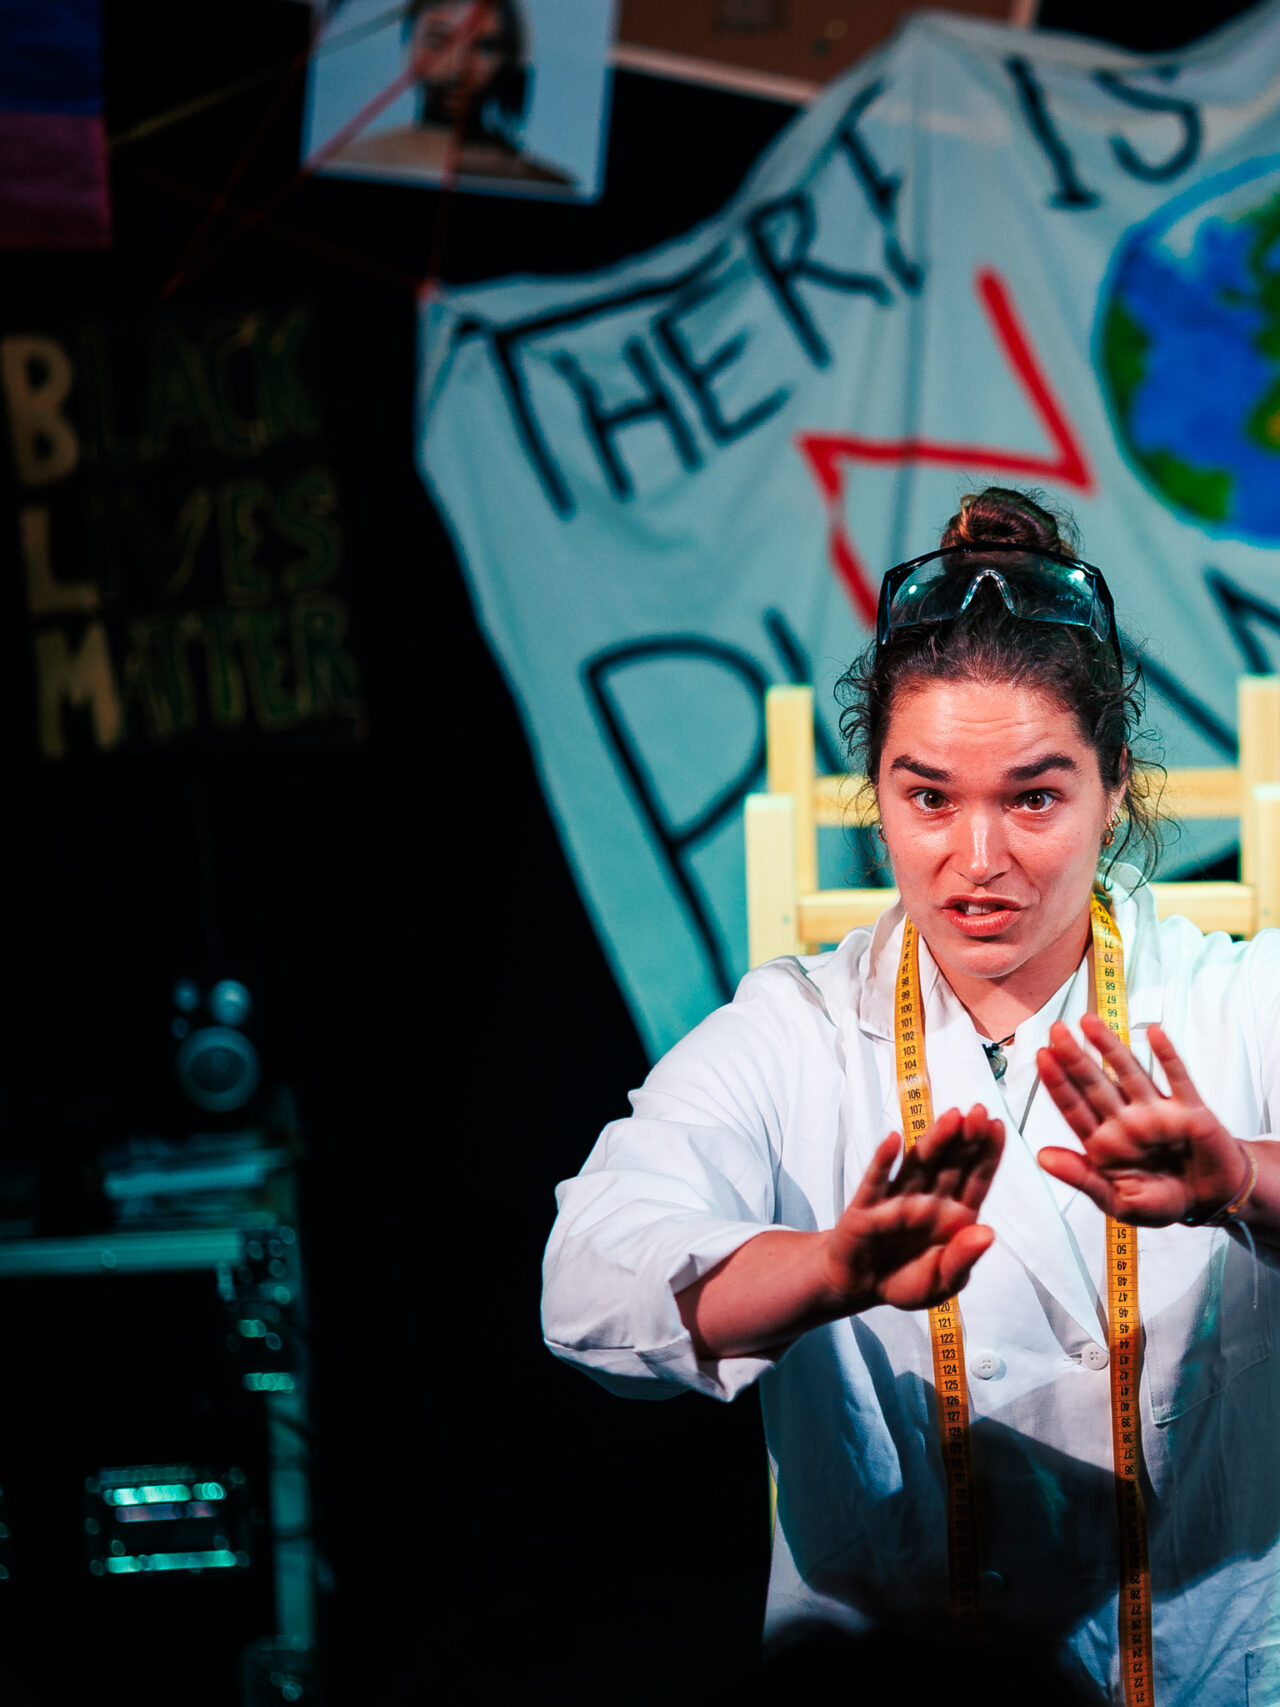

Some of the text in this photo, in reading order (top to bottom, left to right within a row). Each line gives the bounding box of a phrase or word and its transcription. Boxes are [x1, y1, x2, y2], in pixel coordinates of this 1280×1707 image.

[1005, 58, 1200, 210] IS
[0, 305, 325, 492] BLACK
[18, 465, 343, 614] LIVES
[33, 592, 372, 768] MATTER
[1104, 940, 1114, 948] 71
[1104, 954, 1114, 962] 70
[1104, 968, 1114, 976] 69
[1105, 982, 1115, 990] 68
[1107, 996, 1116, 1004] 67
[900, 1003, 912, 1014] 100
[1108, 1008, 1118, 1017] 66
[900, 1017, 912, 1028] 101
[1109, 1022, 1118, 1030] 65
[902, 1031, 914, 1041] 102
[903, 1045, 916, 1056] 103
[904, 1060, 916, 1070] 104
[908, 1088, 920, 1100] 106
[910, 1104, 922, 1114] 107
[912, 1120, 926, 1130] 108
[1117, 1229, 1126, 1239] 51
[1116, 1244, 1127, 1254] 50
[1117, 1260, 1127, 1270] 49
[1117, 1276, 1128, 1286] 48
[1118, 1292, 1128, 1302] 47
[936, 1302, 950, 1312] 120
[1118, 1308, 1128, 1318] 46
[938, 1318, 952, 1328] 121
[1120, 1324, 1130, 1334] 45
[940, 1333, 954, 1344] 122
[1120, 1340, 1130, 1350] 44
[941, 1348, 956, 1359] 123
[1120, 1355, 1130, 1365] 43
[942, 1364, 957, 1374] 124
[1120, 1370, 1129, 1380] 42
[944, 1380, 958, 1390] 125
[1120, 1386, 1130, 1396] 41
[946, 1396, 960, 1406] 126
[1120, 1402, 1130, 1412] 40
[948, 1411, 960, 1422] 127
[1122, 1417, 1132, 1428] 39
[948, 1427, 962, 1438] 128
[1122, 1433, 1132, 1443] 38
[1124, 1449, 1134, 1459] 37
[1124, 1465, 1134, 1475] 36
[1130, 1574, 1140, 1584] 29
[1130, 1590, 1140, 1600] 28
[1131, 1606, 1141, 1615] 27
[1132, 1648, 1142, 1658] 24
[1133, 1663, 1143, 1673] 23
[1134, 1678, 1144, 1688] 22
[1136, 1693, 1144, 1702] 21
